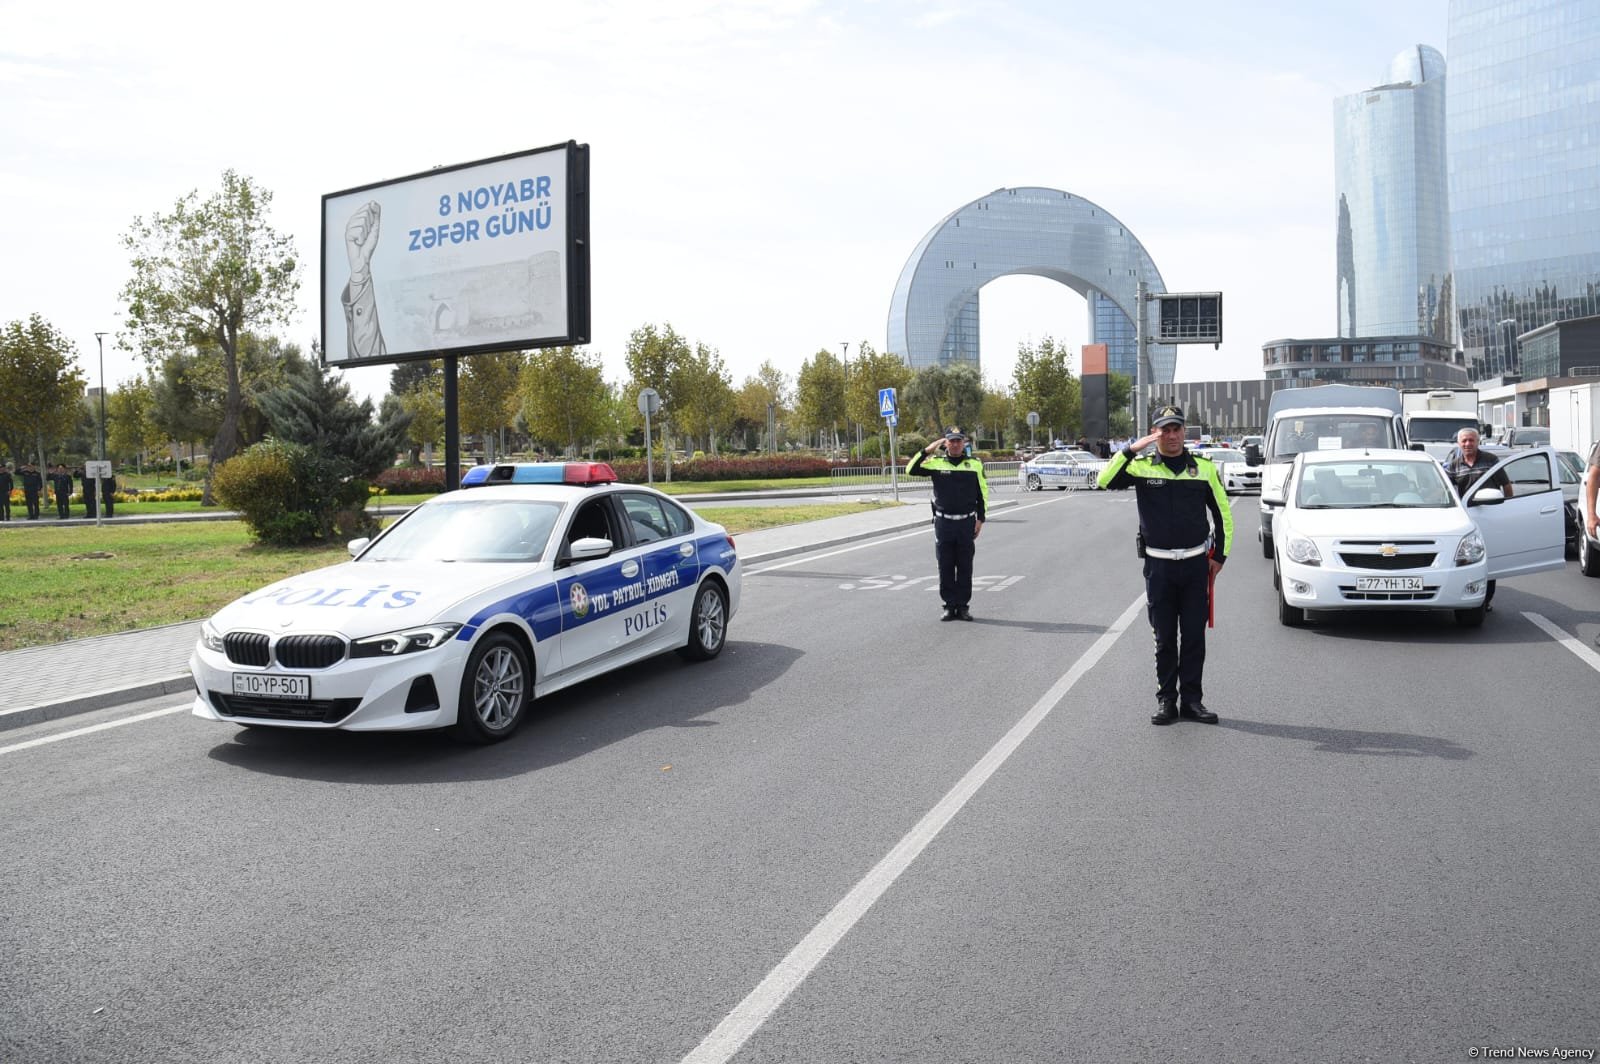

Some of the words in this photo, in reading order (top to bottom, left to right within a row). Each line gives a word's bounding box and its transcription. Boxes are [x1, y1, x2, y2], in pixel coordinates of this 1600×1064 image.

[439, 194, 451, 216] 8
[458, 175, 551, 213] NOYABR
[408, 219, 480, 251] ZƏFƏR
[485, 200, 552, 238] GÜNÜ
[243, 584, 422, 609] POLİS
[592, 594, 610, 614] YOL
[613, 580, 645, 606] PATRUL
[1366, 578, 1420, 590] 77-YH-134
[624, 601, 668, 636] POLİS
[246, 676, 304, 695] 10-YP-501
